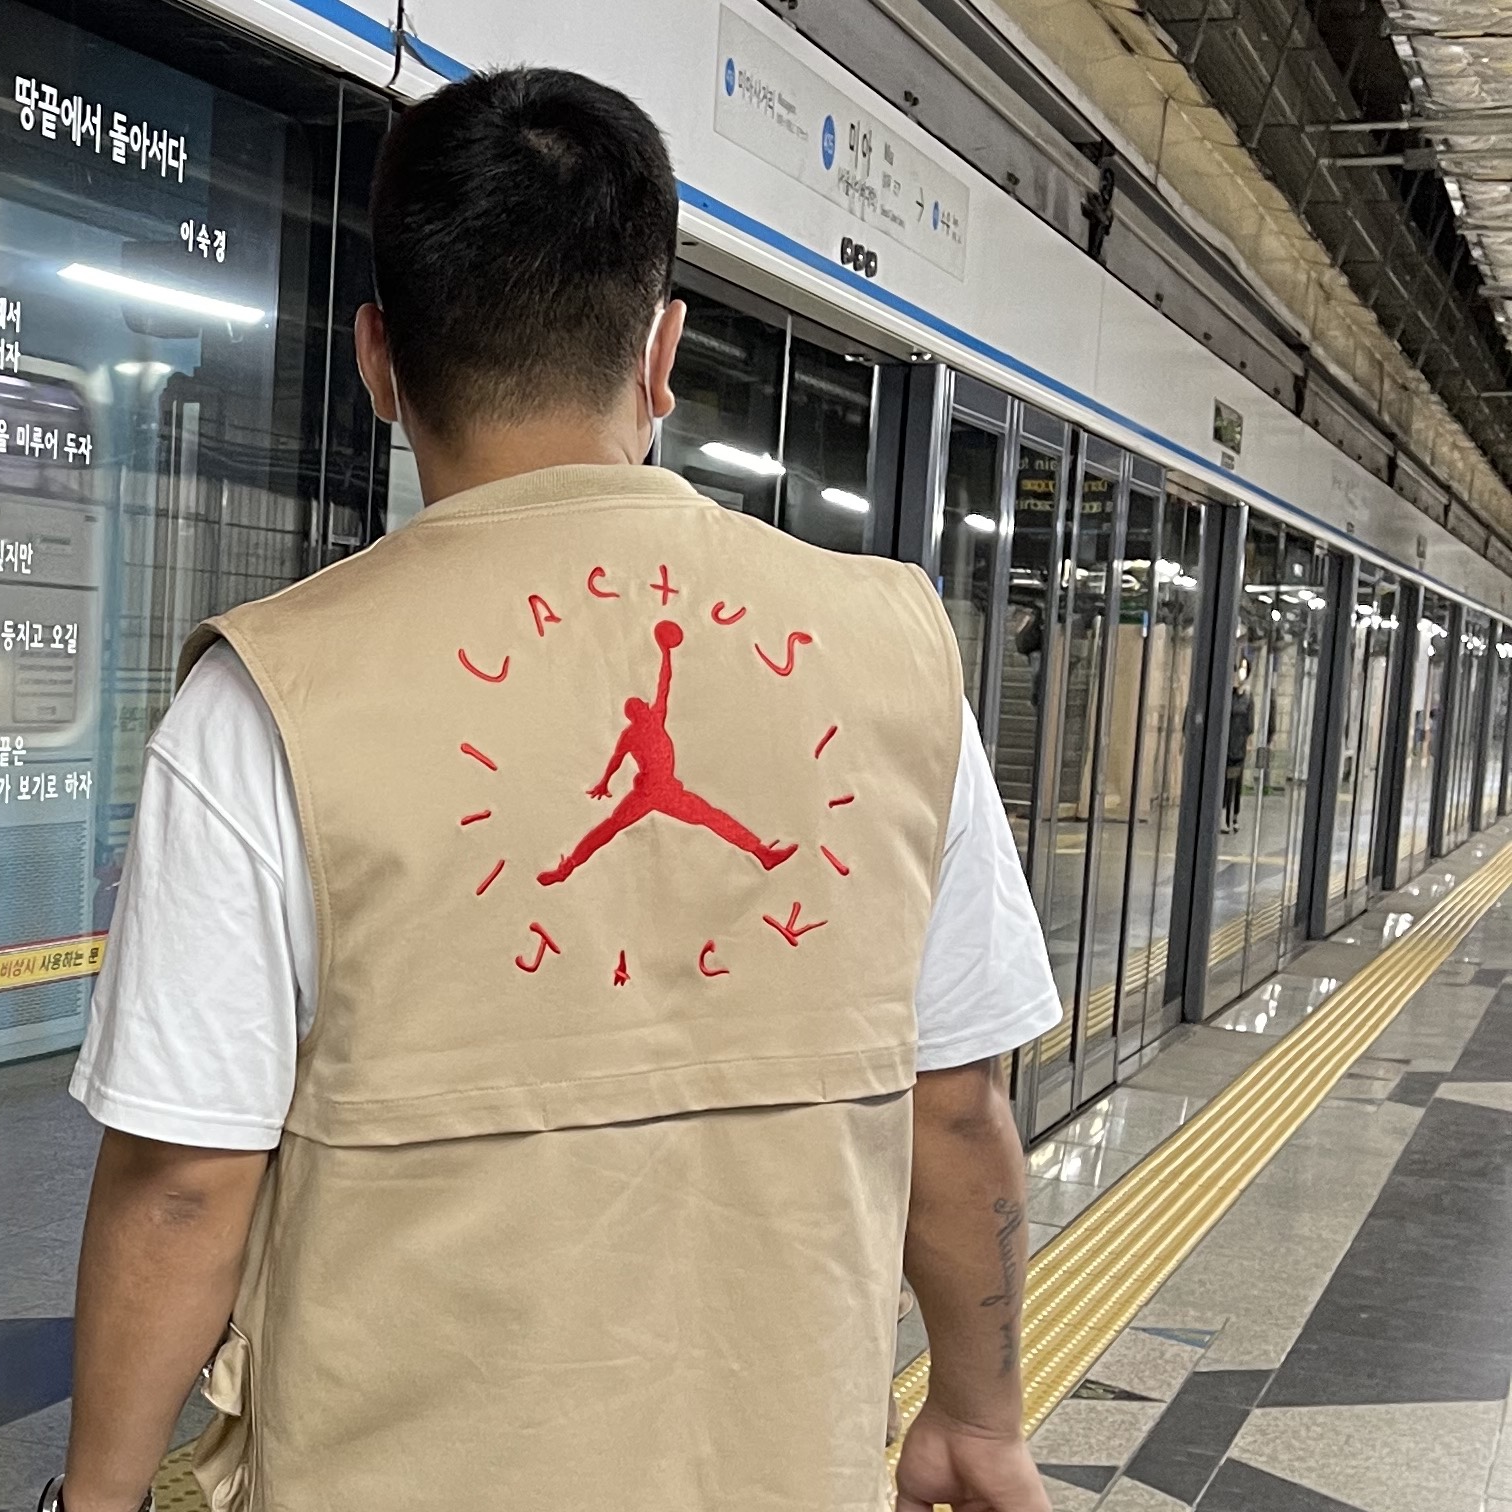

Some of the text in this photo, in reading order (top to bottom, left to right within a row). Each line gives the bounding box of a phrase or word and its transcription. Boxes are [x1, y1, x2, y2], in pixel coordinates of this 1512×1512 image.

[14, 75, 188, 184] 땅끝에서 돌아서다
[848, 120, 873, 178] 미아
[179, 218, 227, 264] 이숙경
[16, 423, 59, 461] 미루어
[63, 432, 94, 465] 두자
[0, 620, 45, 652] 등지고
[50, 622, 79, 655] 오길
[16, 772, 59, 802] 보기로
[64, 770, 94, 800] 하자
[0, 955, 37, 979] 비상시
[39, 950, 85, 972] 사용하는
[515, 902, 829, 986] JACK
